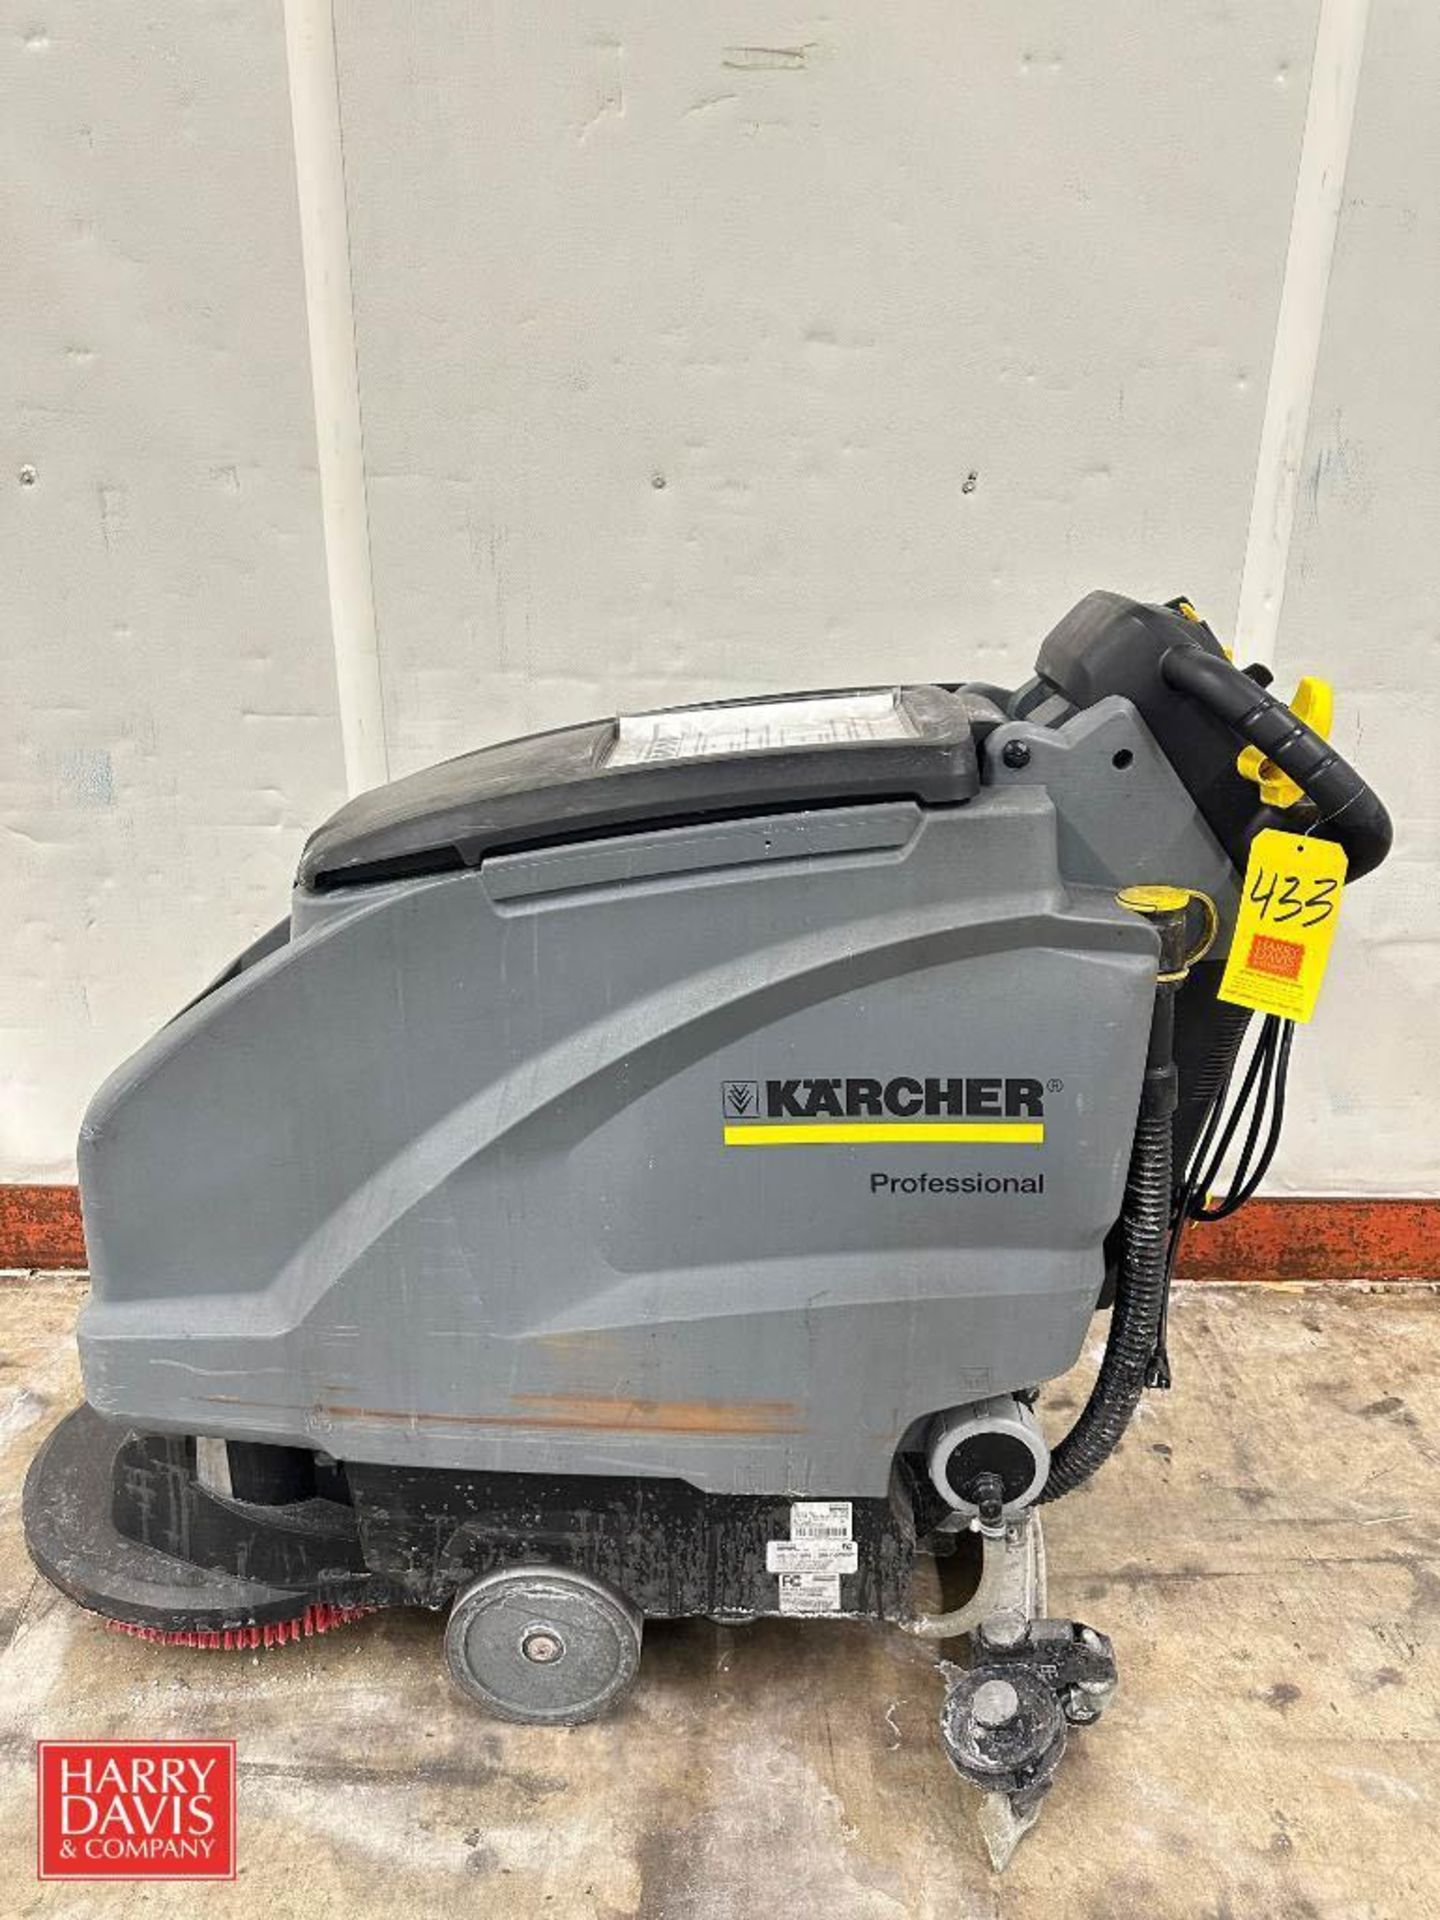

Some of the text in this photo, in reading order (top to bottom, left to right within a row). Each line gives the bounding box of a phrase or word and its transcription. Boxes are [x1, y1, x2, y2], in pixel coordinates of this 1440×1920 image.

[1250, 866, 1338, 928] 433
[765, 1077, 1045, 1118] KÄRCHER
[870, 1172, 1045, 1195] Professional
